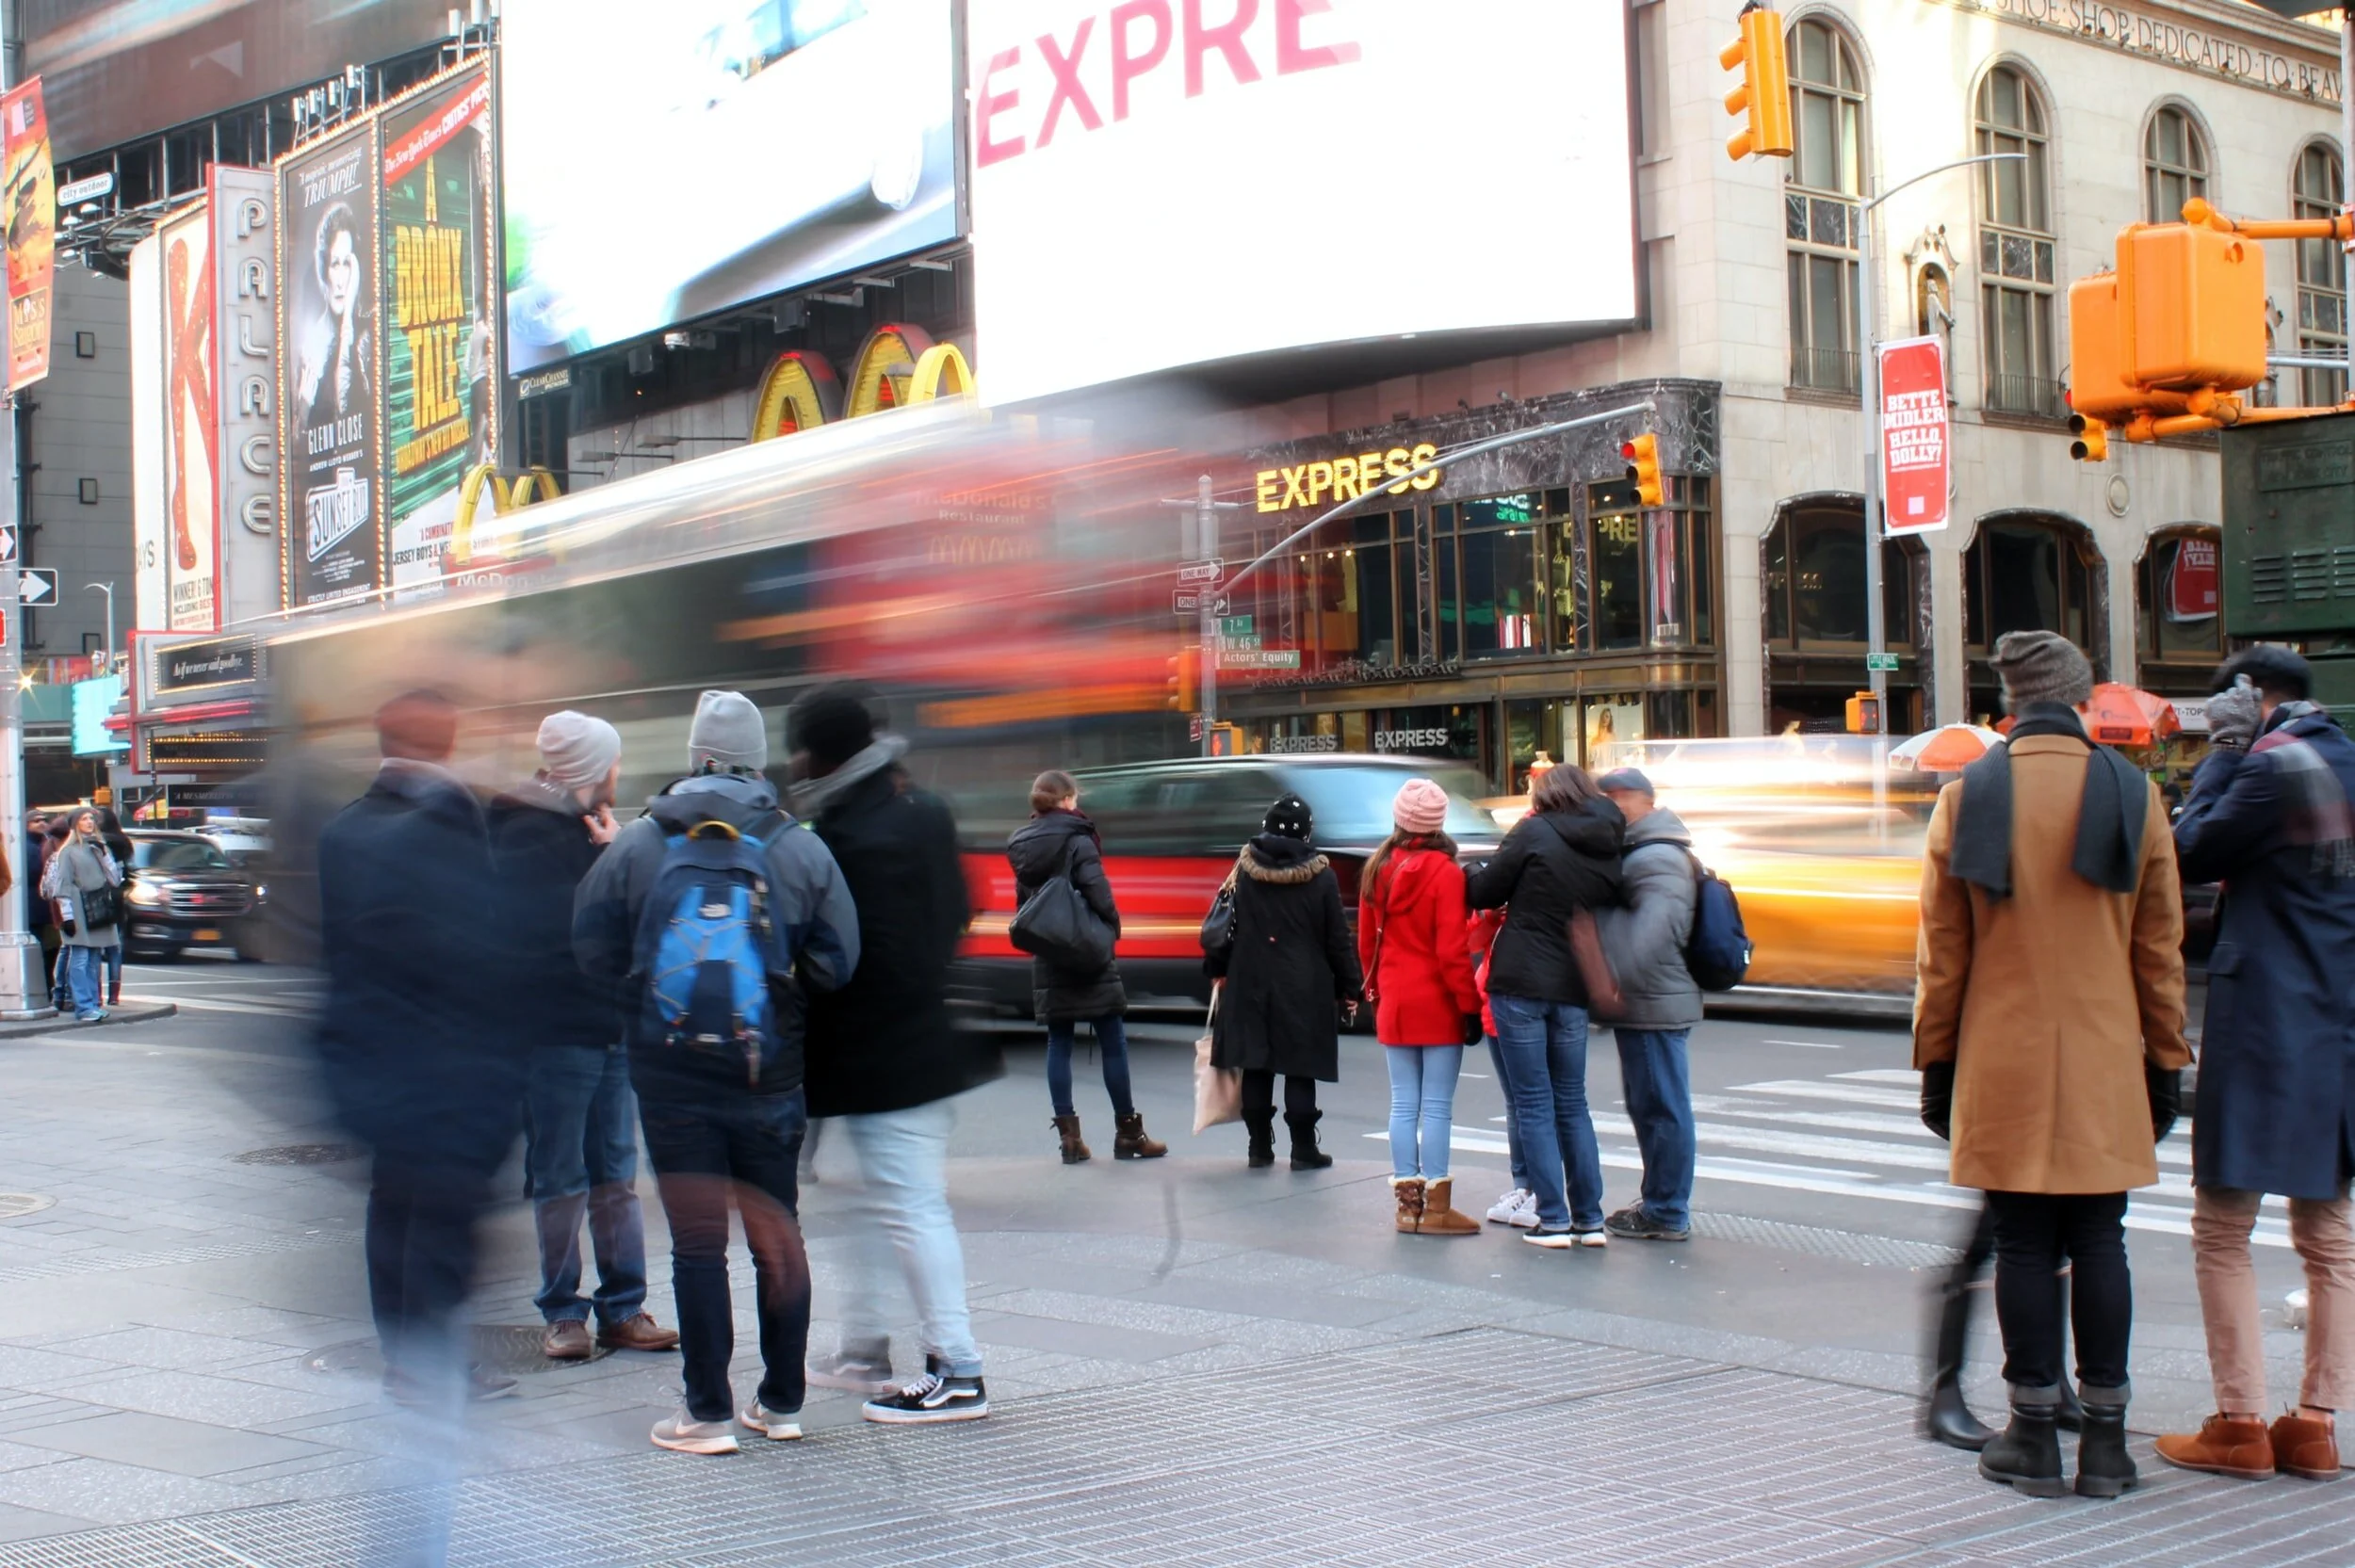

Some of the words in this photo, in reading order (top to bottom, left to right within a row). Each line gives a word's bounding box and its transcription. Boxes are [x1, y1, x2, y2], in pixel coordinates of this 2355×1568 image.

[2070, 0, 2129, 40] SHOP
[2137, 17, 2251, 75] DEDICATED
[2259, 53, 2289, 86] TO
[2298, 63, 2342, 101] BEAV
[426, 154, 437, 222] A
[397, 225, 463, 328] BRONX
[237, 196, 271, 534] PALACE
[408, 321, 460, 432] TALE
[1887, 389, 1941, 412] BETTE
[1884, 406, 1945, 429] MIDLER
[309, 423, 333, 455] GLENN
[338, 412, 362, 446] CLOSE
[1889, 427, 1942, 449] HELLO,
[1890, 445, 1942, 466] DOLLY!
[1257, 444, 1438, 513] EXPRESS
[314, 491, 350, 548] SUNSET
[393, 549, 415, 565] JERSEY
[416, 544, 432, 561] BOYS
[1182, 569, 1196, 579] ONE
[1197, 567, 1210, 576] WAY
[1179, 597, 1195, 607] ONE
[1226, 638, 1236, 650] W
[1240, 637, 1251, 650] 46
[1225, 653, 1259, 663] Actors'
[1262, 653, 1294, 664] Equity
[1270, 735, 1338, 753] EXPRESS
[1374, 728, 1448, 749] EXPRESS
